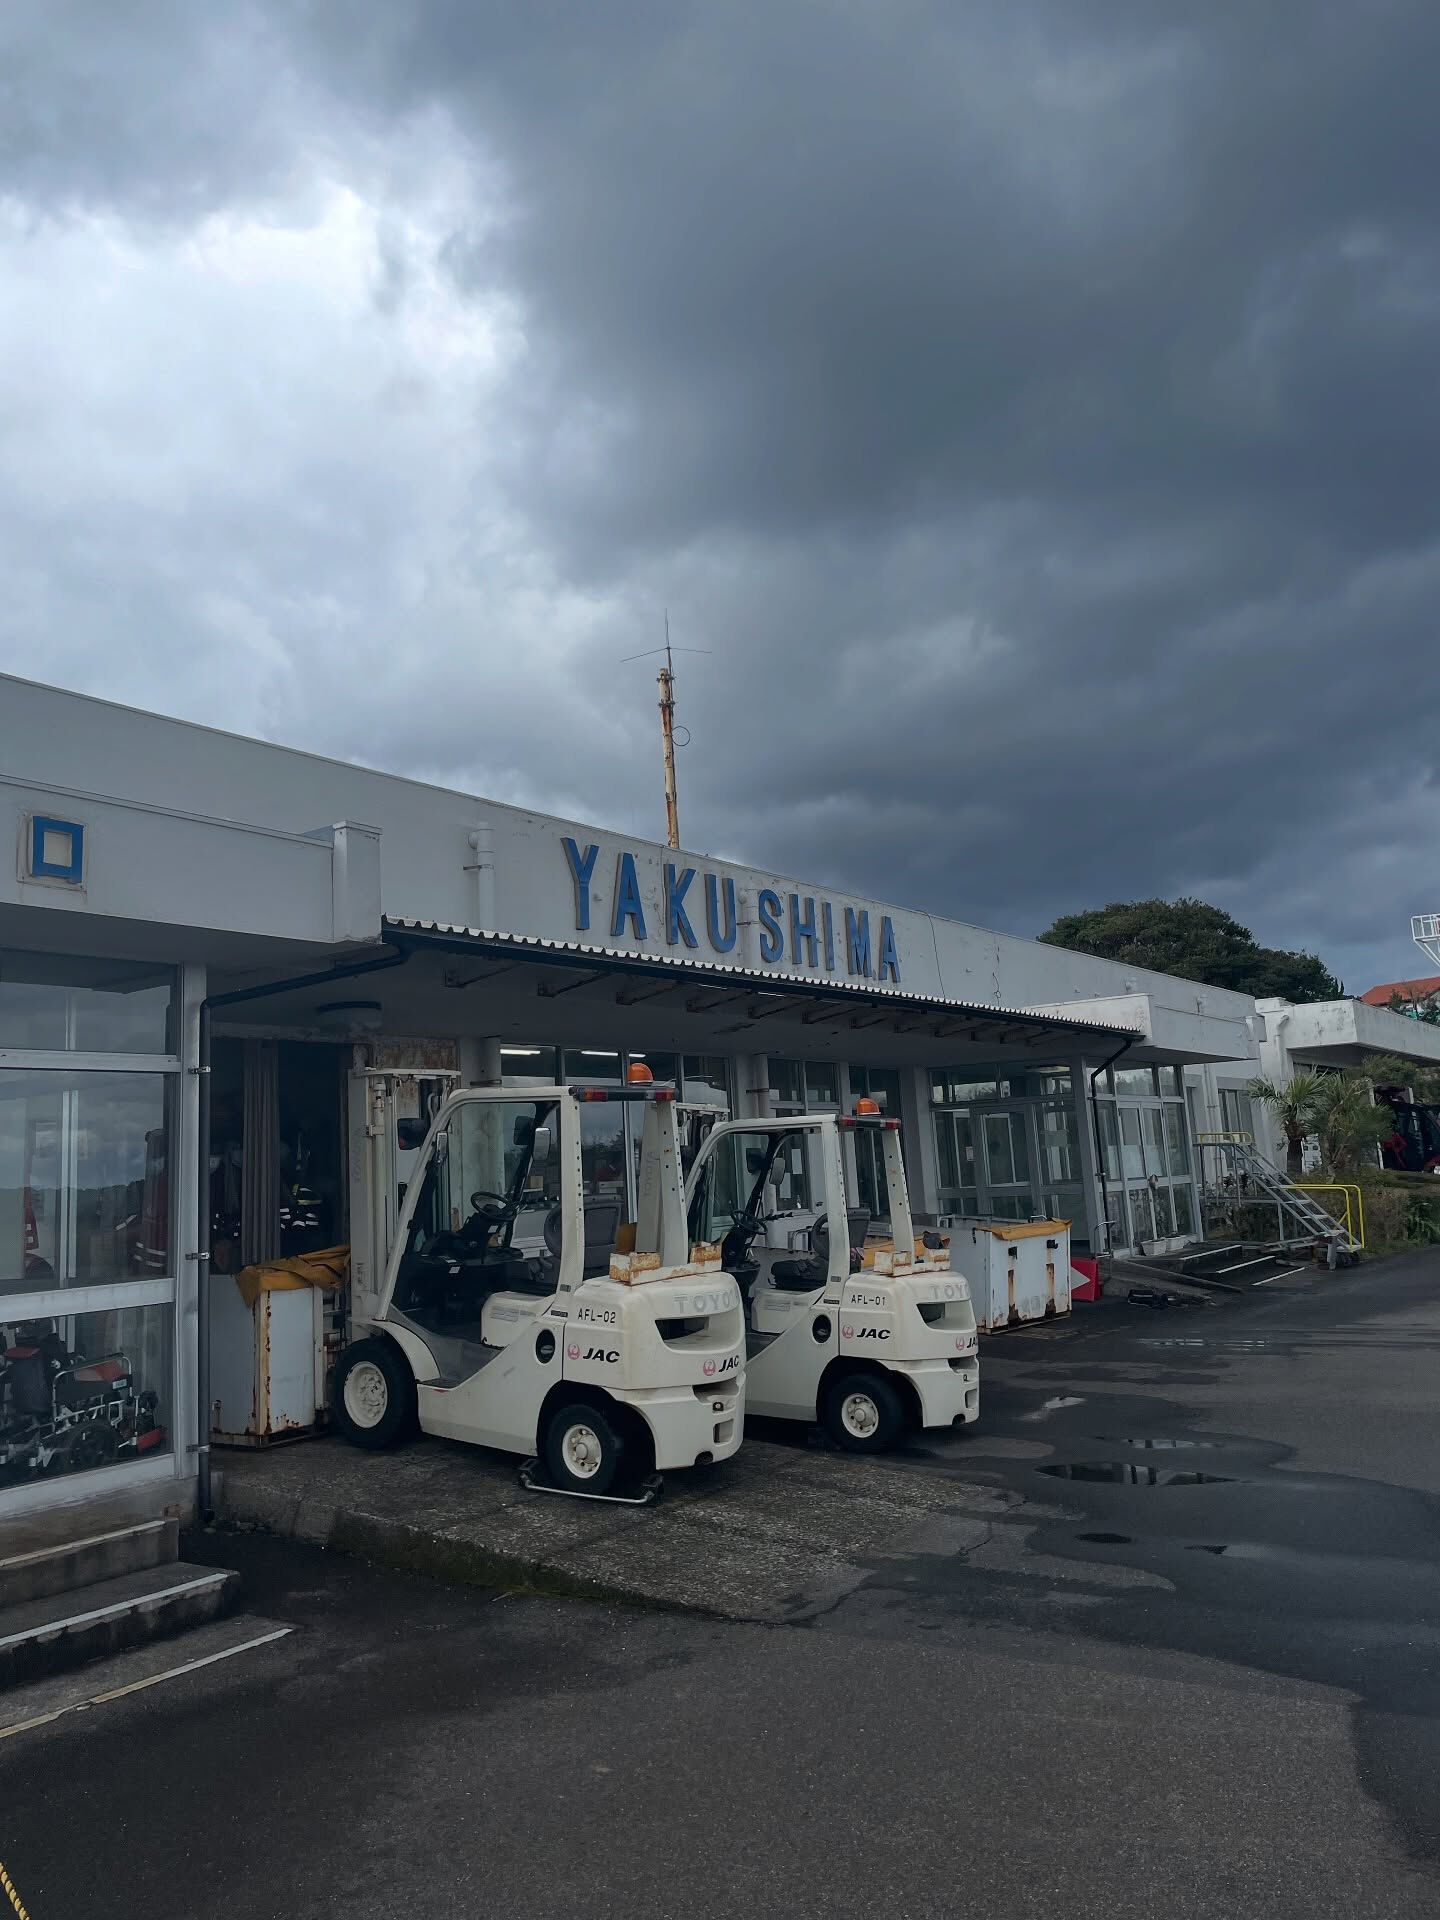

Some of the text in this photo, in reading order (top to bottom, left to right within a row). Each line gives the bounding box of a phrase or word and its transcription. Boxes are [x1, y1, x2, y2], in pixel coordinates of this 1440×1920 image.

[560, 837, 900, 983] YAKUSHIMA
[851, 1294, 886, 1306] AFL-01
[577, 1308, 616, 1323] AFL-02
[857, 1327, 891, 1340] JAC
[582, 1347, 620, 1363] JAC
[718, 1355, 740, 1373] JAC
